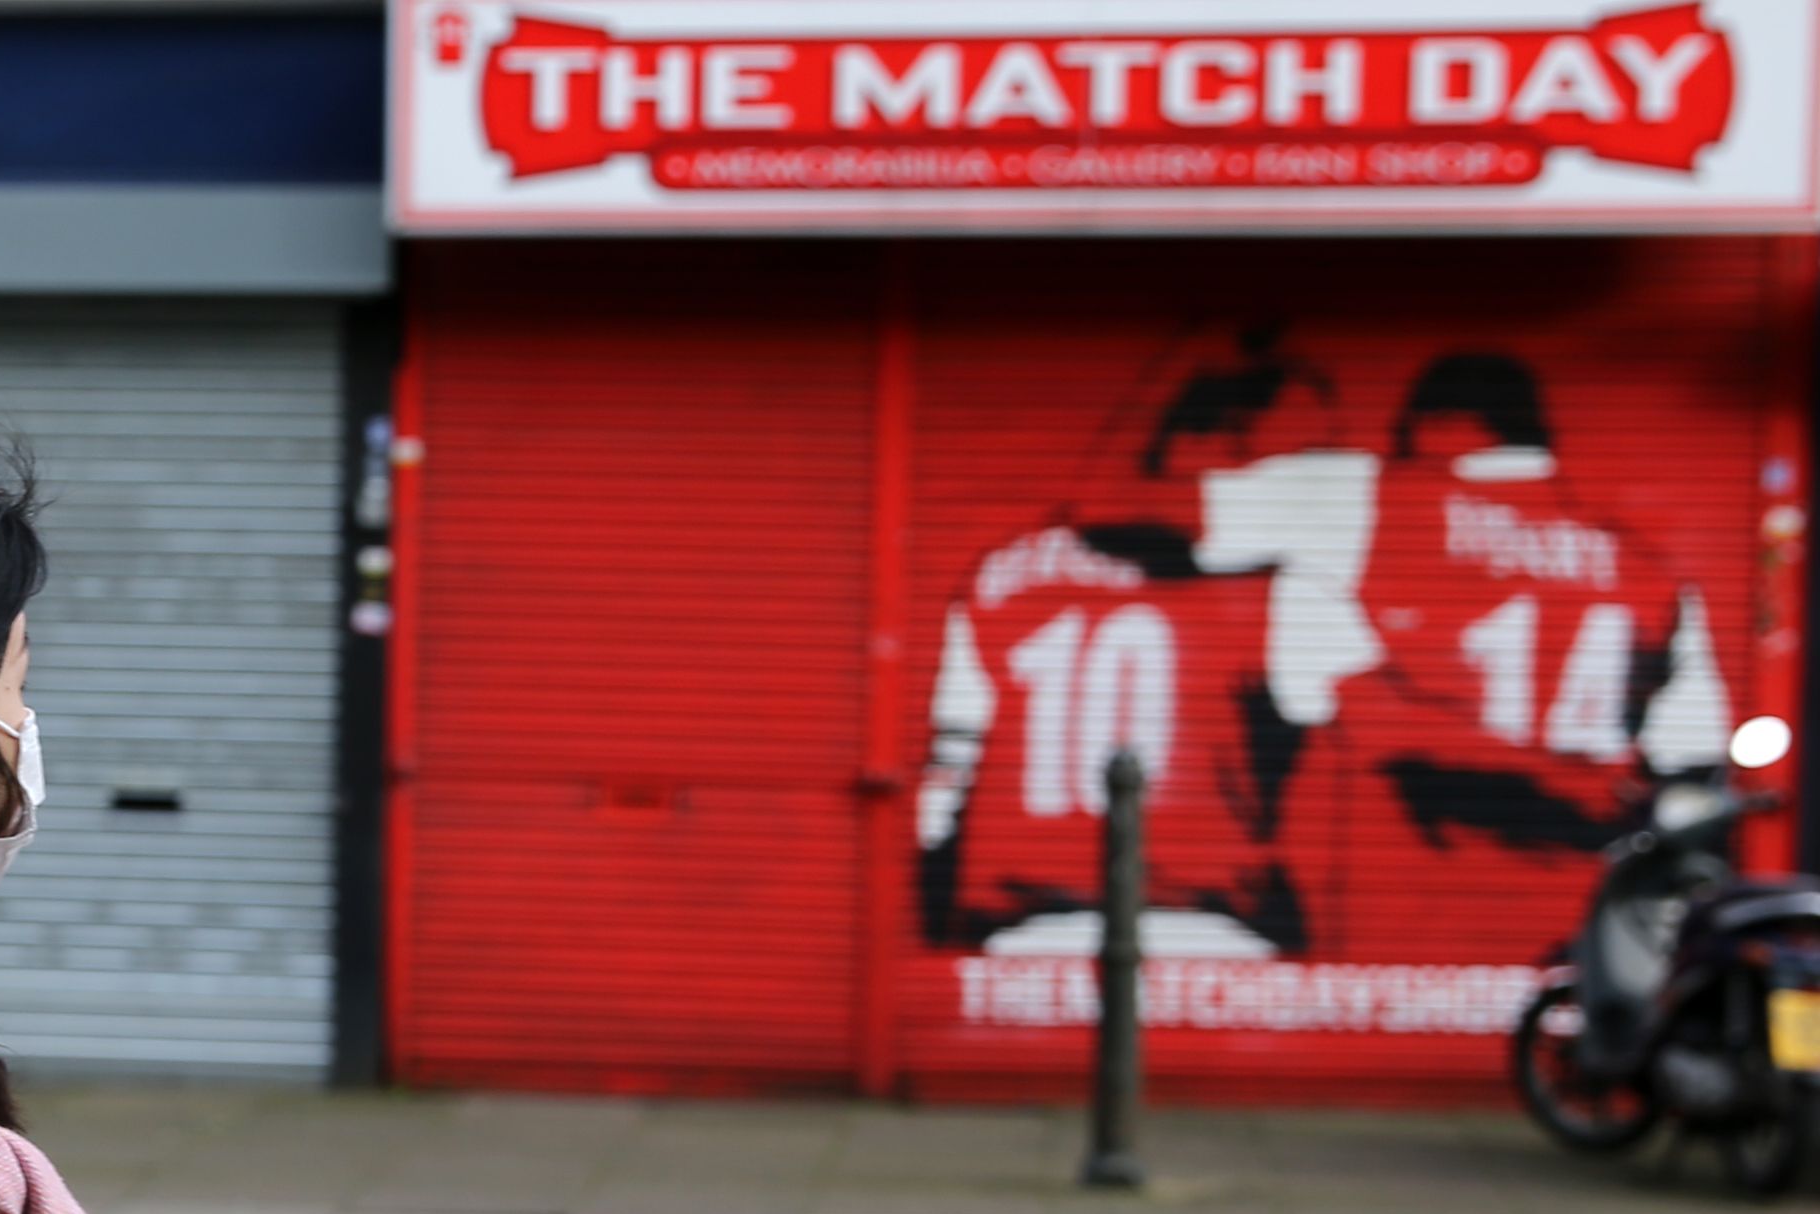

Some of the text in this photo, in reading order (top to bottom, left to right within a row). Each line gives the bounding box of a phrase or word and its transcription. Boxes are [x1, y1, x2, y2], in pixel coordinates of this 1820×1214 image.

[500, 34, 1718, 130] THE MATCH DAY
[1254, 145, 1359, 184] FAN
[1367, 144, 1502, 184] SHOP
[1006, 604, 1176, 818] 10
[1460, 594, 1635, 764] 14
